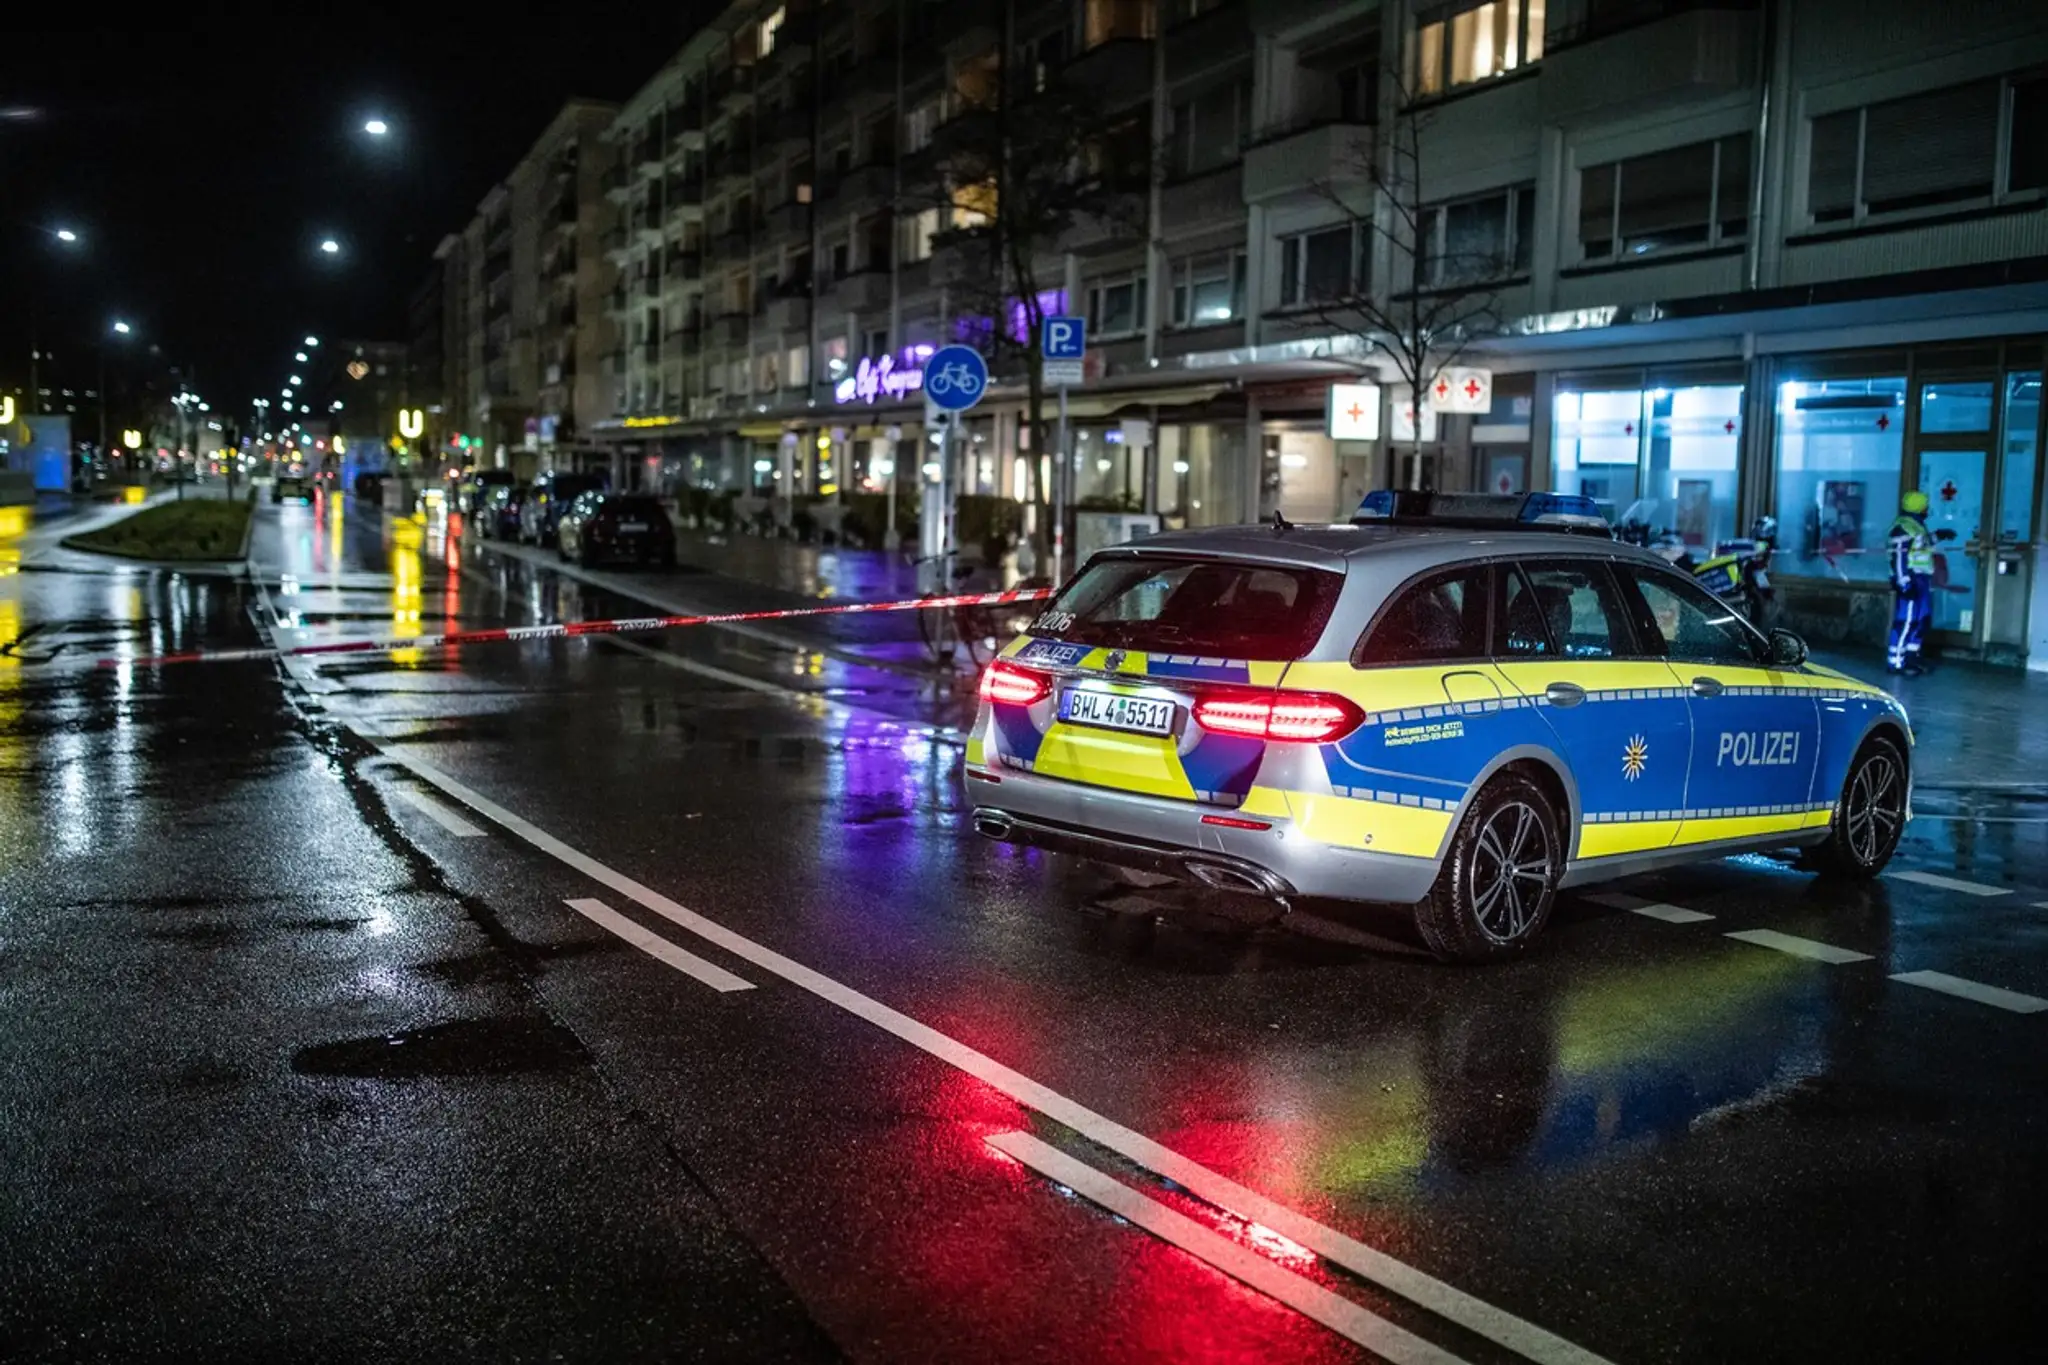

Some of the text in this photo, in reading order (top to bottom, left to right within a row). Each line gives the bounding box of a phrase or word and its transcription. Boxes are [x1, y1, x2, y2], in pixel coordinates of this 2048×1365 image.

[1049, 321, 1073, 354] P
[399, 409, 424, 438] U
[1027, 644, 1077, 660] POLIZEI
[1070, 694, 1100, 720] BWL
[1126, 701, 1168, 729] 5511
[1717, 732, 1800, 766] POLIZEI
